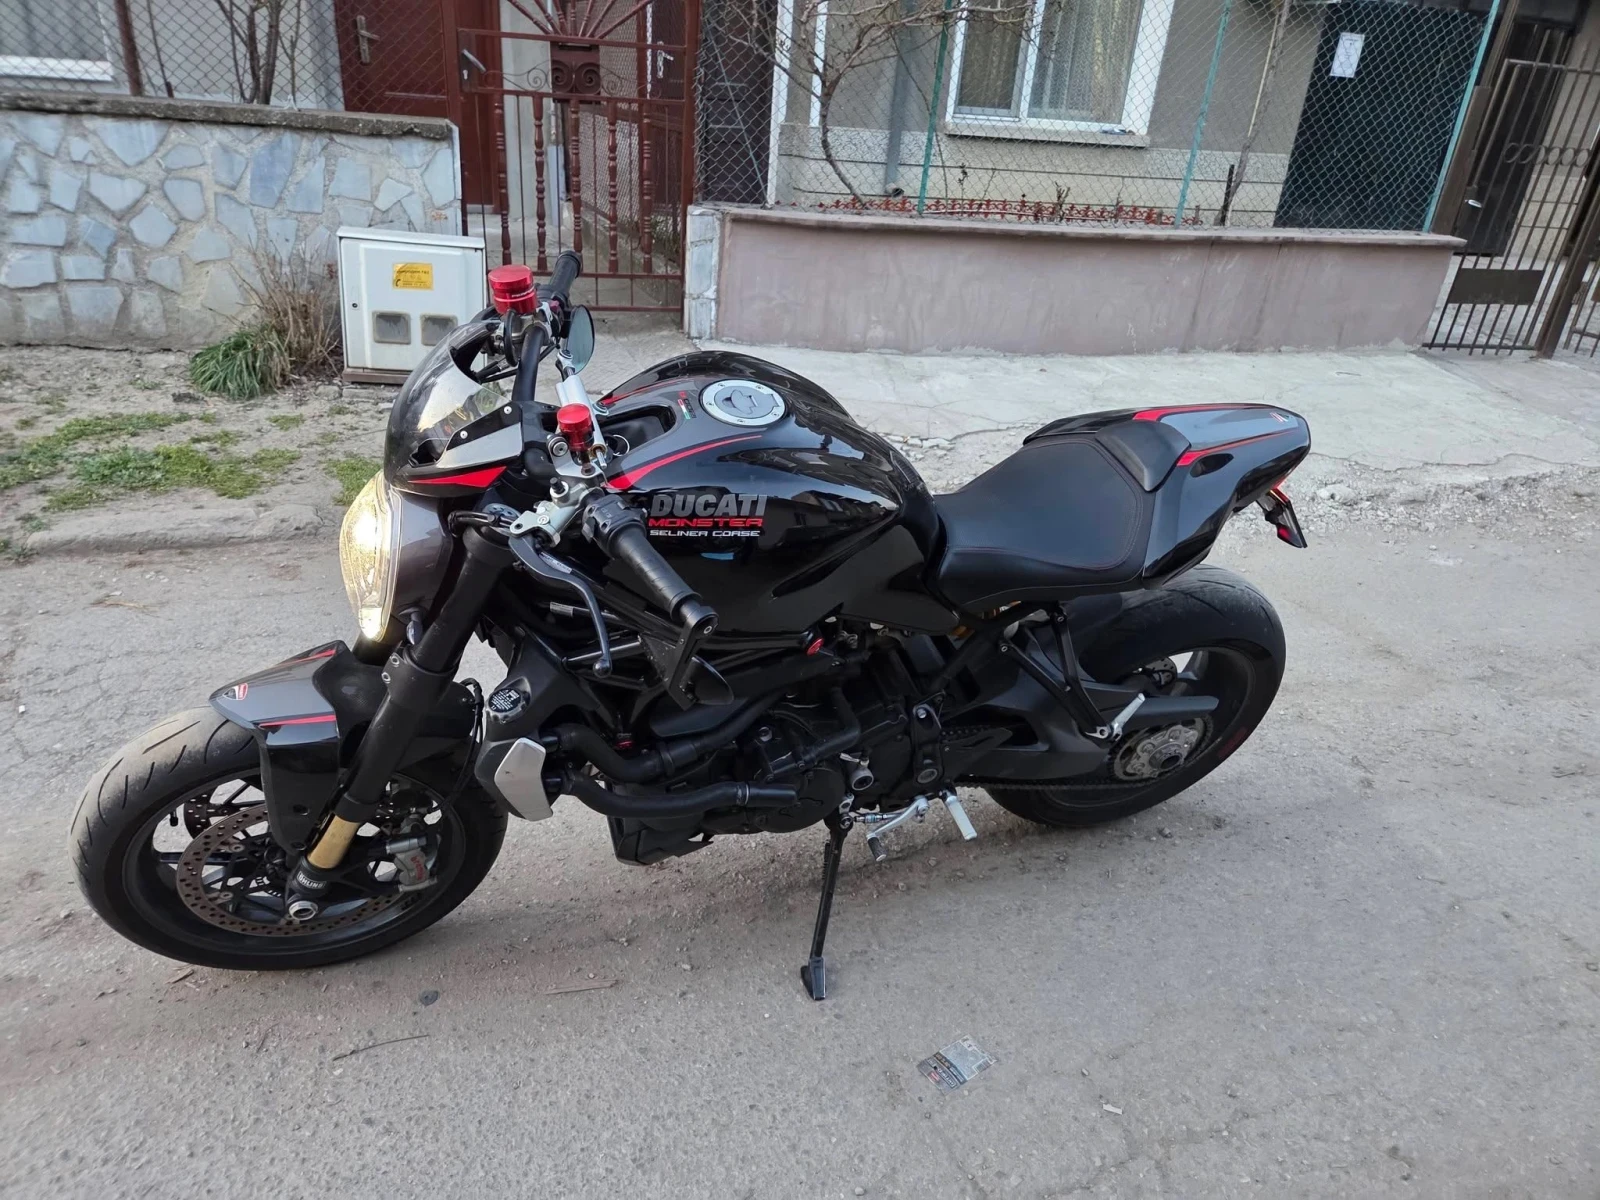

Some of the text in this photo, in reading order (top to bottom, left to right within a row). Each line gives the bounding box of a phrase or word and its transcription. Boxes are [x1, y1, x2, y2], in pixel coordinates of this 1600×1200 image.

[650, 494, 768, 517] DUCATI
[648, 518, 763, 527] MONSTER
[650, 529, 708, 537] SELINER
